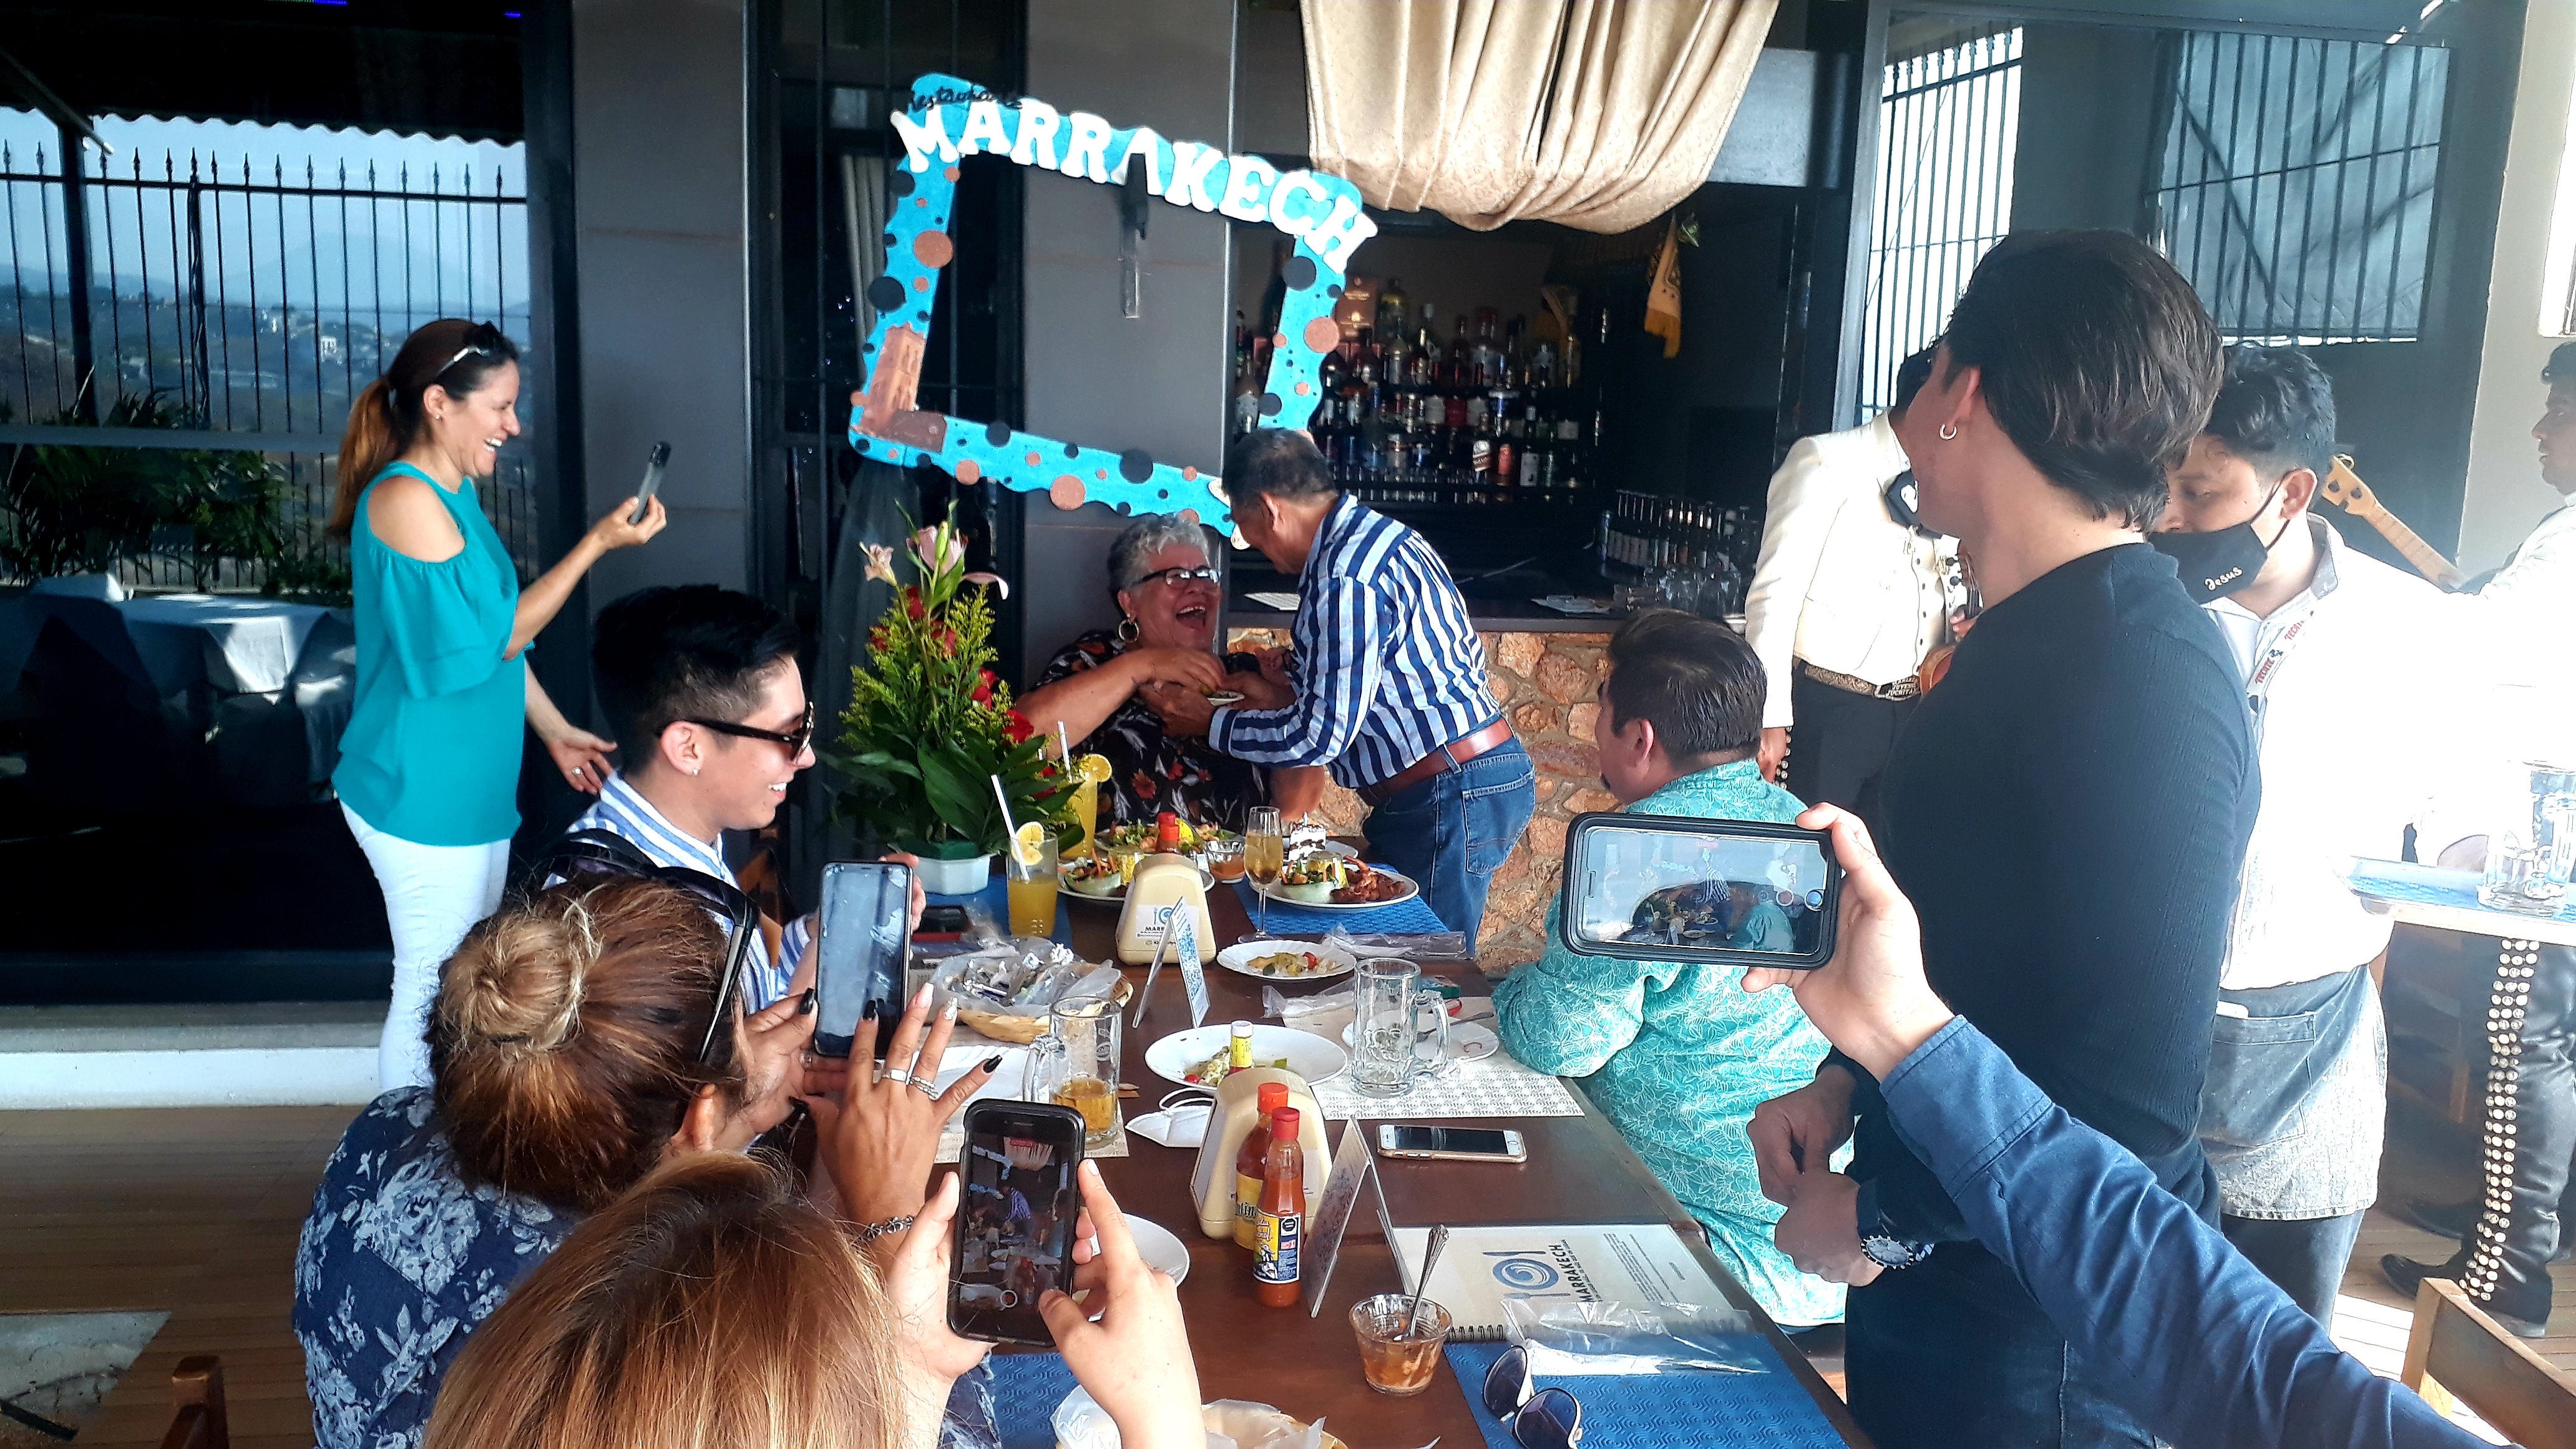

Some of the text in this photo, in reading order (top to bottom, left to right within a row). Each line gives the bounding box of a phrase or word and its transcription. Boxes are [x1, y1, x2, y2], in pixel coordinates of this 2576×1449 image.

[890, 96, 1378, 274] MARRAKECH
[2204, 566, 2243, 591] Jesus
[1548, 1244, 1596, 1302] MARRAKECH
